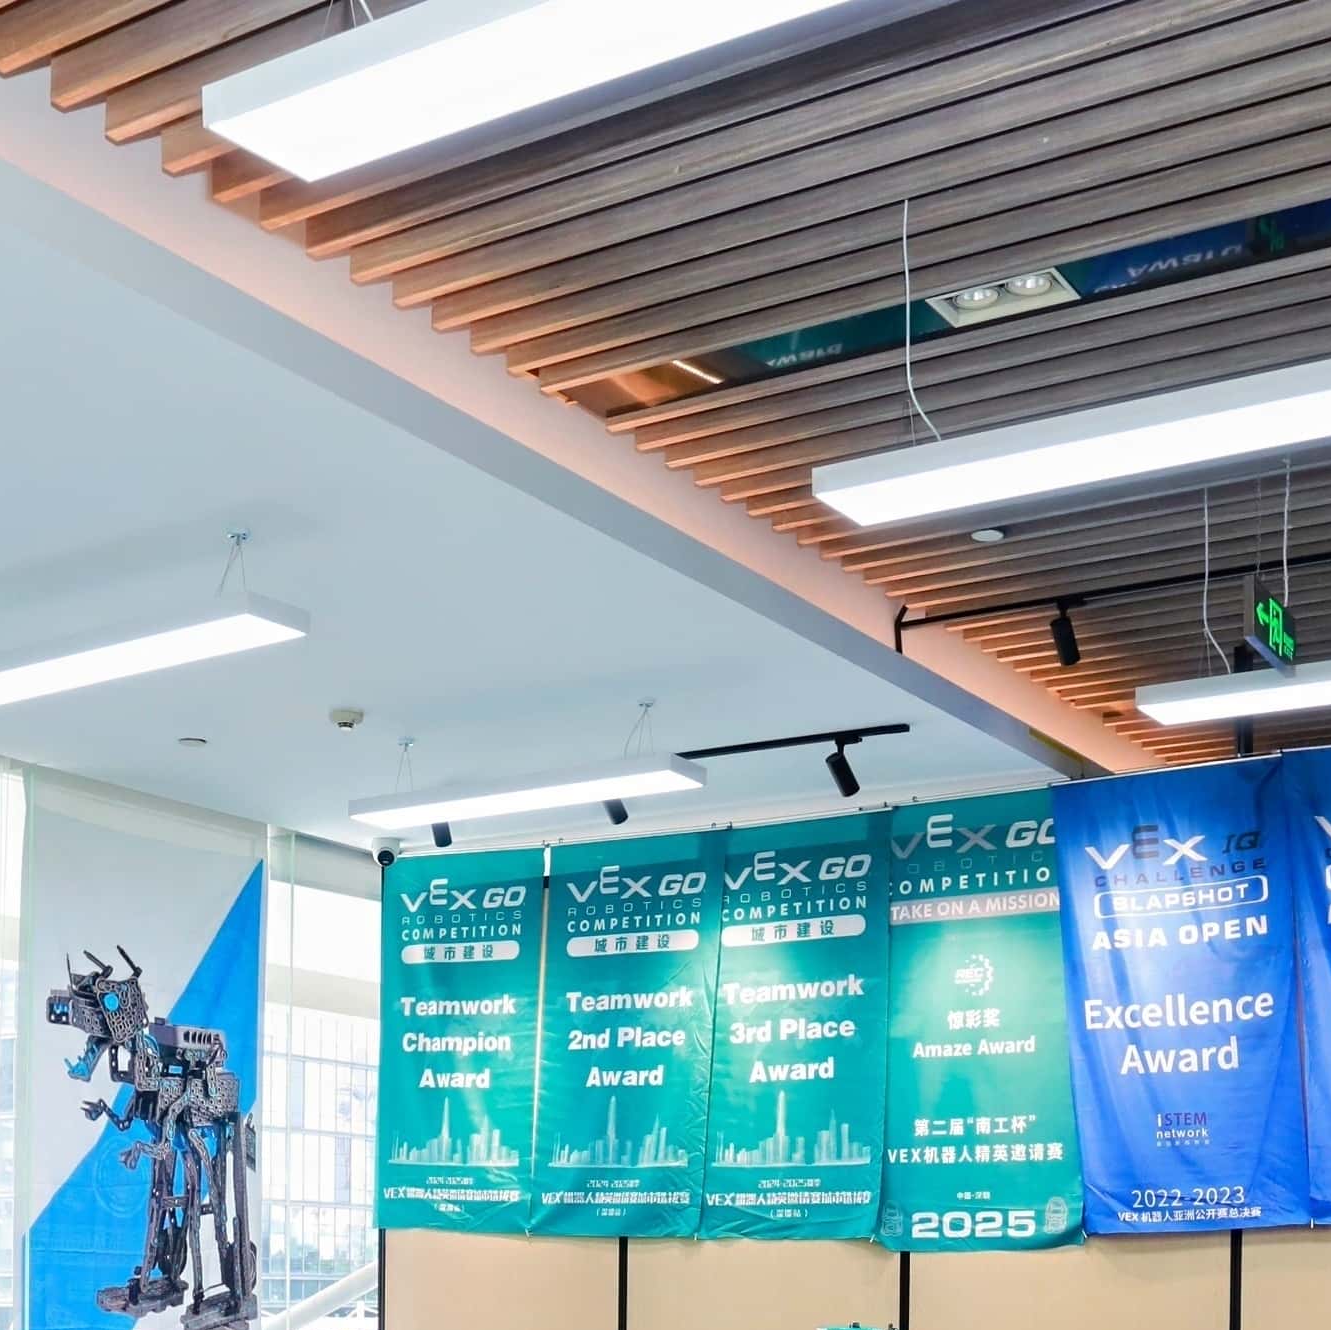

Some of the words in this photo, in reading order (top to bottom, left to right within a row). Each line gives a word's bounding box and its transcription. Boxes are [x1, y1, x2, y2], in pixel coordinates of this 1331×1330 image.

[891, 814, 997, 859] VEX
[1085, 824, 1208, 871] VEX
[1222, 830, 1261, 855] IQ
[725, 851, 813, 890] VEX
[819, 854, 871, 880] GO
[890, 867, 1050, 896] OMPETITIO
[1094, 857, 1267, 888] CHALLENGE
[400, 878, 477, 913] VEX
[482, 886, 526, 908] GO
[566, 865, 652, 903] VEX
[658, 872, 706, 896] GO
[568, 898, 701, 917] ROBOTICS
[722, 896, 867, 921] COMPETITION
[891, 903, 932, 921] TAKE
[937, 902, 964, 917] ON
[969, 903, 980, 914] A
[986, 891, 1060, 911] MISSION
[1112, 883, 1250, 913] SLAPSHOT
[402, 911, 522, 925] ROBOTICS
[568, 912, 700, 932] COMPETITION
[751, 920, 835, 942] 城市建设
[402, 924, 521, 941] COMPETITION
[594, 934, 670, 952] 城市建设
[1092, 927, 1168, 950] ASIA
[1179, 916, 1268, 945] OPEN
[424, 945, 493, 960] 城市建设
[566, 986, 694, 1012] Teamwork
[723, 974, 864, 1005] Teamwork
[401, 994, 516, 1016] Teamwork
[1085, 991, 1274, 1030] Excellence
[568, 1028, 610, 1050] 2nd
[617, 1027, 686, 1047] Place
[730, 1021, 772, 1044] 3rd
[780, 1018, 855, 1041] Place
[402, 1033, 511, 1056] Champion
[913, 1041, 972, 1059] Amaze
[977, 1036, 1036, 1055] Award
[1120, 1035, 1238, 1075] Award
[419, 1068, 490, 1089] Award
[586, 1065, 664, 1088] Award
[749, 1057, 834, 1083] Award
[1157, 1128, 1209, 1139] network
[1131, 1186, 1245, 1208] 2022-2023
[911, 1210, 1036, 1238] 2025
